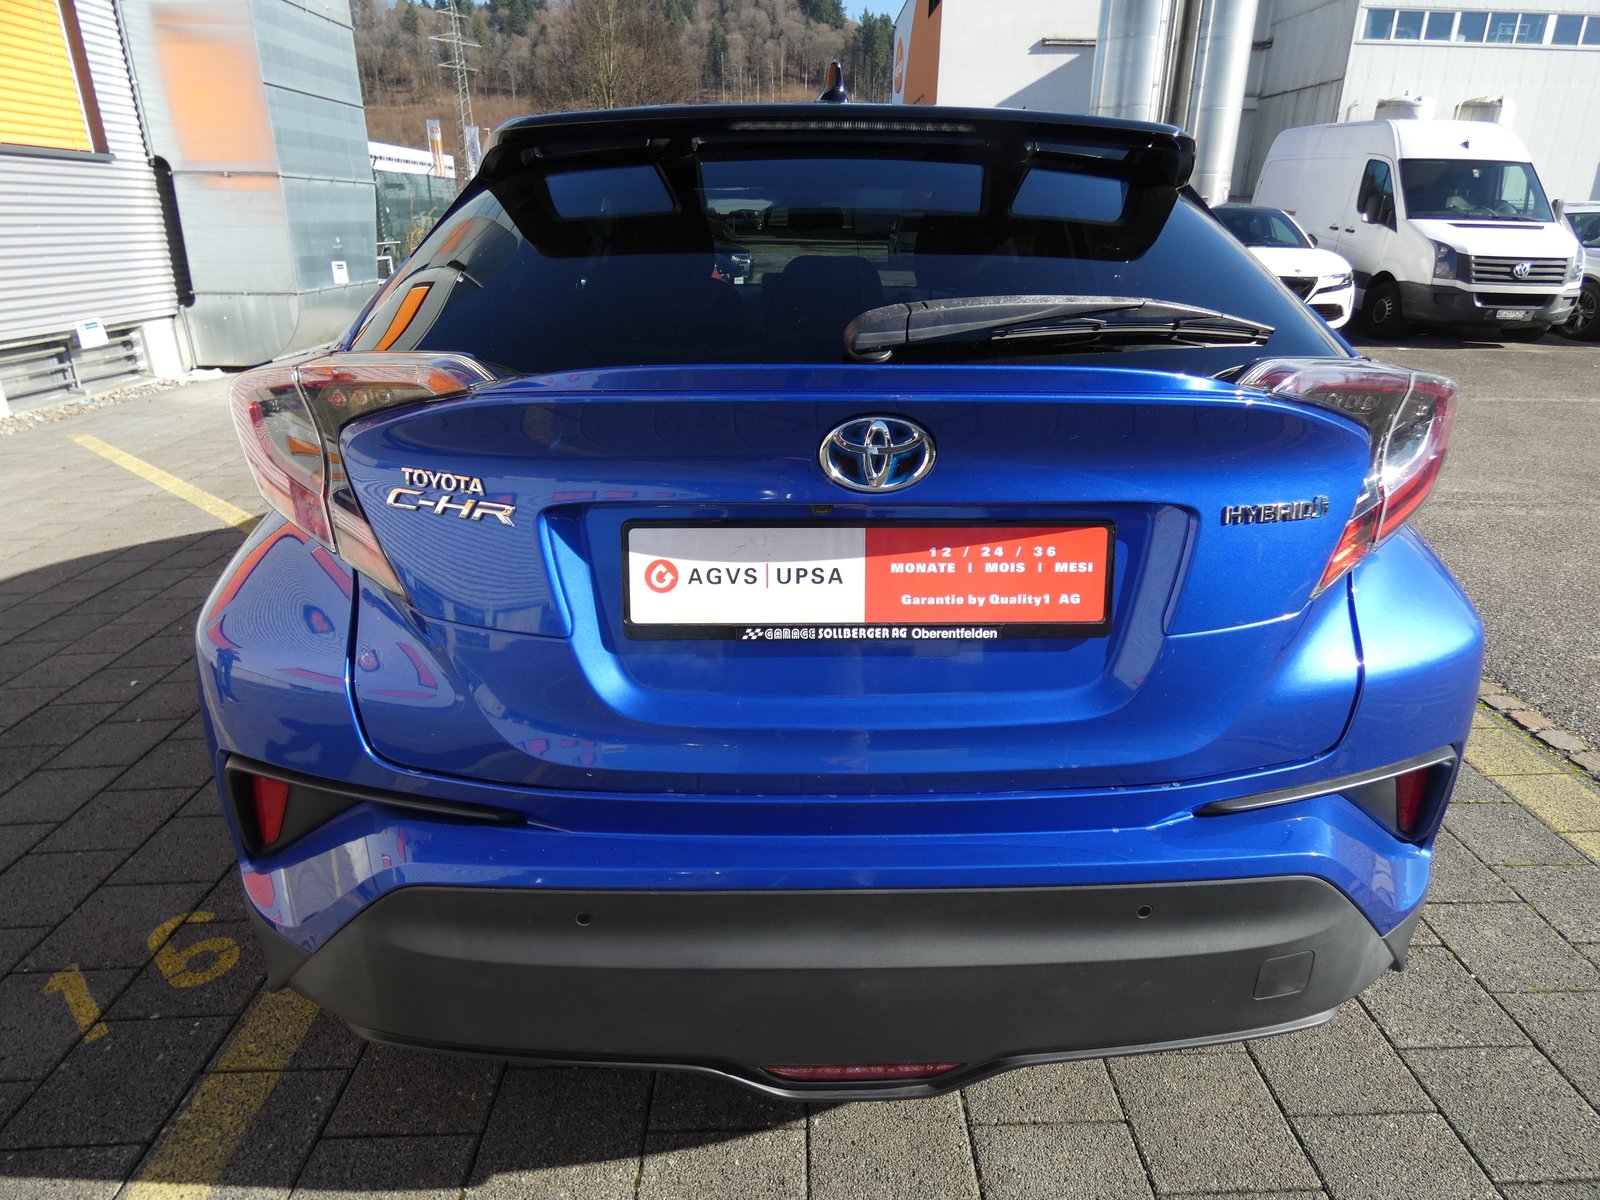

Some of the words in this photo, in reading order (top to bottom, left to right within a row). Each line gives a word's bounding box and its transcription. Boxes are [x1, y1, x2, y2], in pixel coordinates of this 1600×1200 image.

[400, 466, 486, 497] TOYOTA
[386, 487, 517, 527] C-HR
[1221, 501, 1317, 526] HYBRID
[928, 546, 952, 558] 12
[980, 546, 1004, 558] 24
[1032, 546, 1057, 557] 36
[890, 562, 957, 574] MONATE
[984, 562, 1026, 573] MOIS
[1054, 561, 1094, 573] MESI
[687, 567, 759, 586] AGVS
[775, 567, 844, 586] UPSA
[901, 594, 965, 606] Garantie
[967, 594, 986, 607] by
[989, 593, 1051, 607] Quality1
[1058, 594, 1082, 605] AG
[764, 628, 816, 641] GARAGE
[817, 627, 890, 640] SOLLBERGER
[891, 627, 908, 639] AG
[911, 627, 998, 640] Oberentfelden
